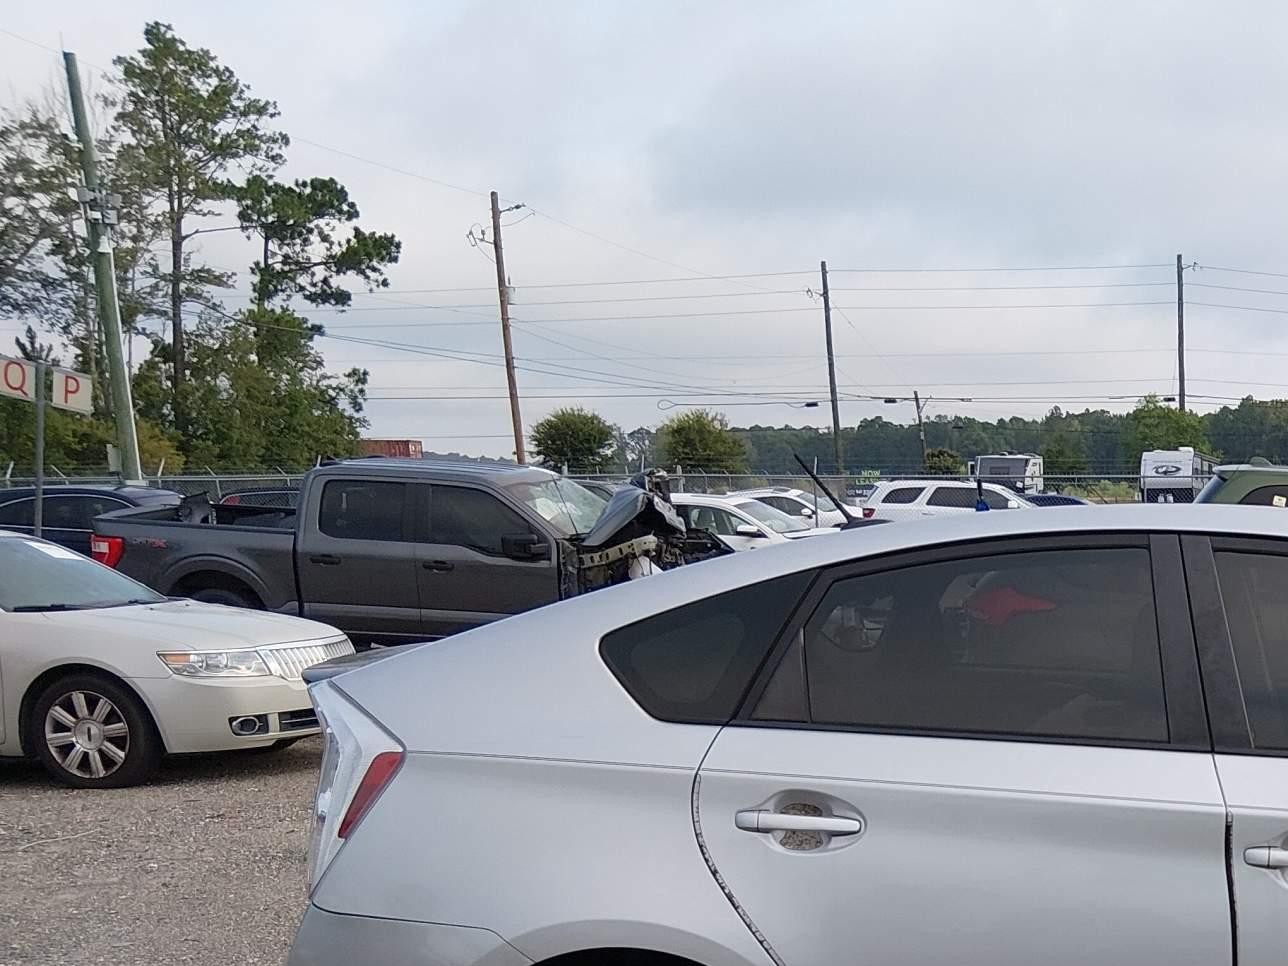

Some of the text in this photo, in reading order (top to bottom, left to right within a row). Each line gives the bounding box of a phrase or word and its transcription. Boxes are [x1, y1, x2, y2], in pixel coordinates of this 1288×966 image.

[4, 361, 29, 397] Q
[64, 375, 80, 404] P
[861, 469, 881, 478] NOW
